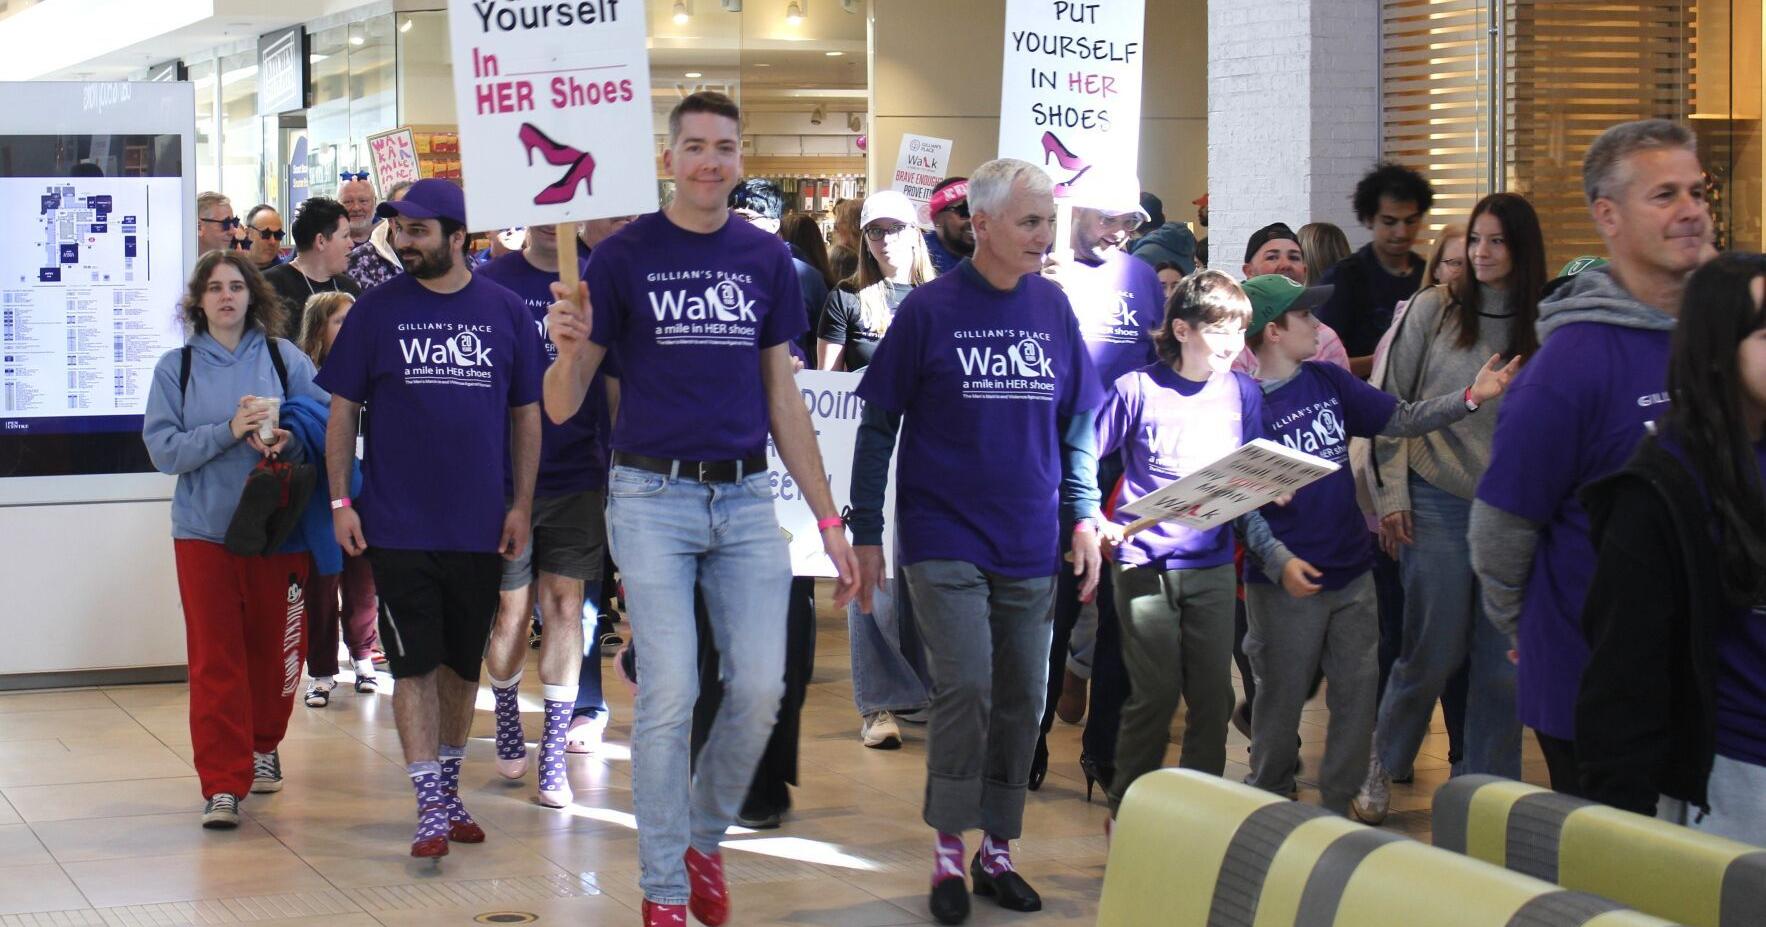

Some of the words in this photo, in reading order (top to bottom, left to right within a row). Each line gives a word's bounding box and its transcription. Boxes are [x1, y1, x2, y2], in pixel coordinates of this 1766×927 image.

[473, 0, 618, 33] Yourself
[1053, 1, 1100, 24] PUT
[1013, 31, 1138, 63] YOURSELF
[472, 47, 499, 78] In
[1031, 68, 1056, 89] IN
[1069, 71, 1117, 98] HER
[476, 81, 535, 115] HER
[551, 77, 633, 109] Shoes
[1032, 103, 1110, 132] SHOES
[896, 170, 915, 184] BRAVE
[903, 185, 923, 198] PROVE
[647, 270, 712, 281] GILLIAN'S
[717, 271, 752, 283] PLACE
[397, 322, 453, 331] GILLIAN'S
[457, 323, 492, 333] PLACE
[655, 326, 662, 335] a
[664, 323, 689, 334] mile
[692, 323, 702, 333] in
[705, 323, 727, 334] HER
[728, 324, 755, 335] shoes
[1114, 327, 1139, 336] shoes
[461, 335, 472, 347] 20
[954, 330, 1015, 338] GILLIAN'S
[1019, 330, 1051, 341] PLACE
[413, 366, 434, 375] mile
[436, 367, 445, 375] in
[447, 367, 464, 376] HER
[466, 368, 492, 378] shoes
[972, 379, 993, 389] mile
[995, 380, 1004, 389] in
[1006, 380, 1028, 389] HER
[1030, 380, 1055, 390] shoes
[1272, 407, 1312, 431] ILLIAN'S
